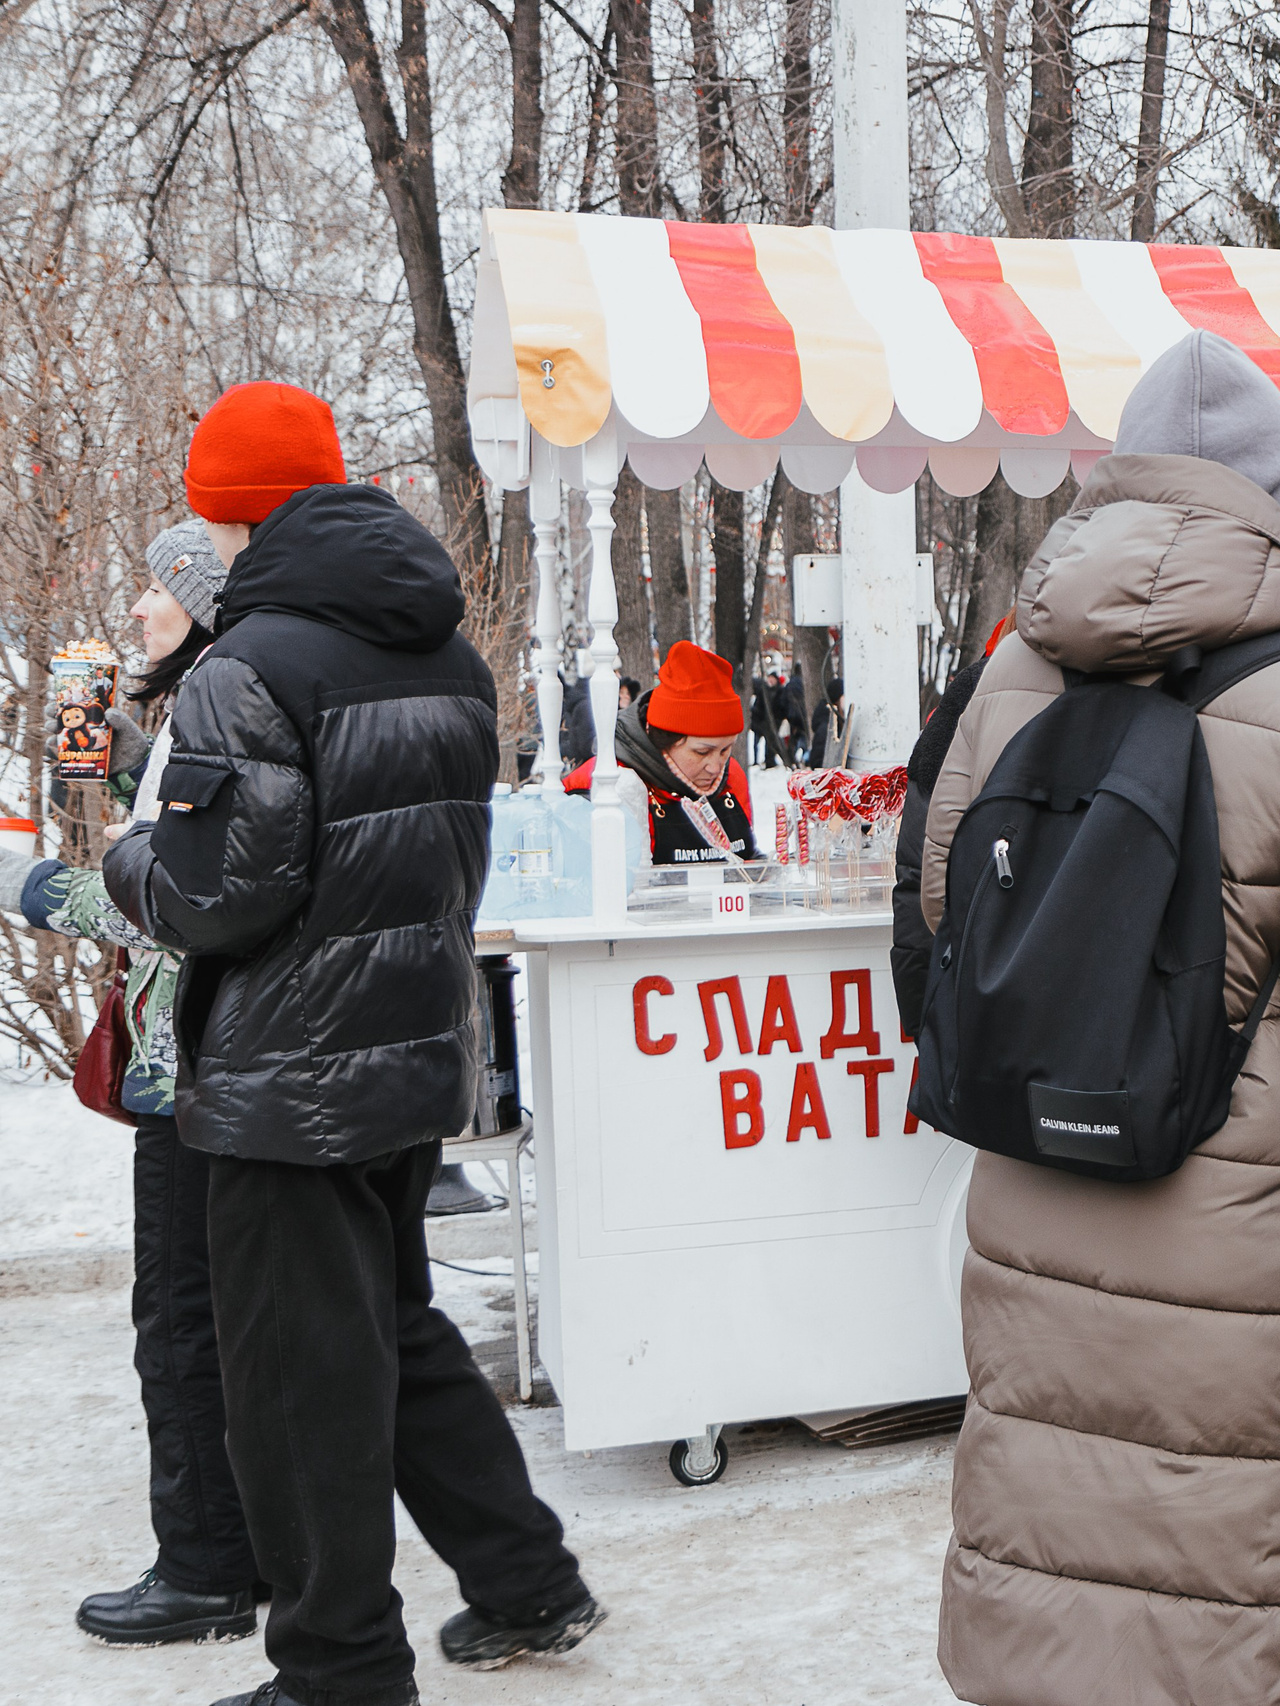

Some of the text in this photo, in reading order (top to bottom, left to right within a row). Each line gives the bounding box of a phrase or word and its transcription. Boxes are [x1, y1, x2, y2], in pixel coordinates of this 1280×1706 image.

[674, 848, 699, 861] ПАРК
[719, 895, 744, 912] 100
[632, 968, 915, 1062] СЛАД
[1041, 1117, 1120, 1135] CALVIN KLEIN JEANS
